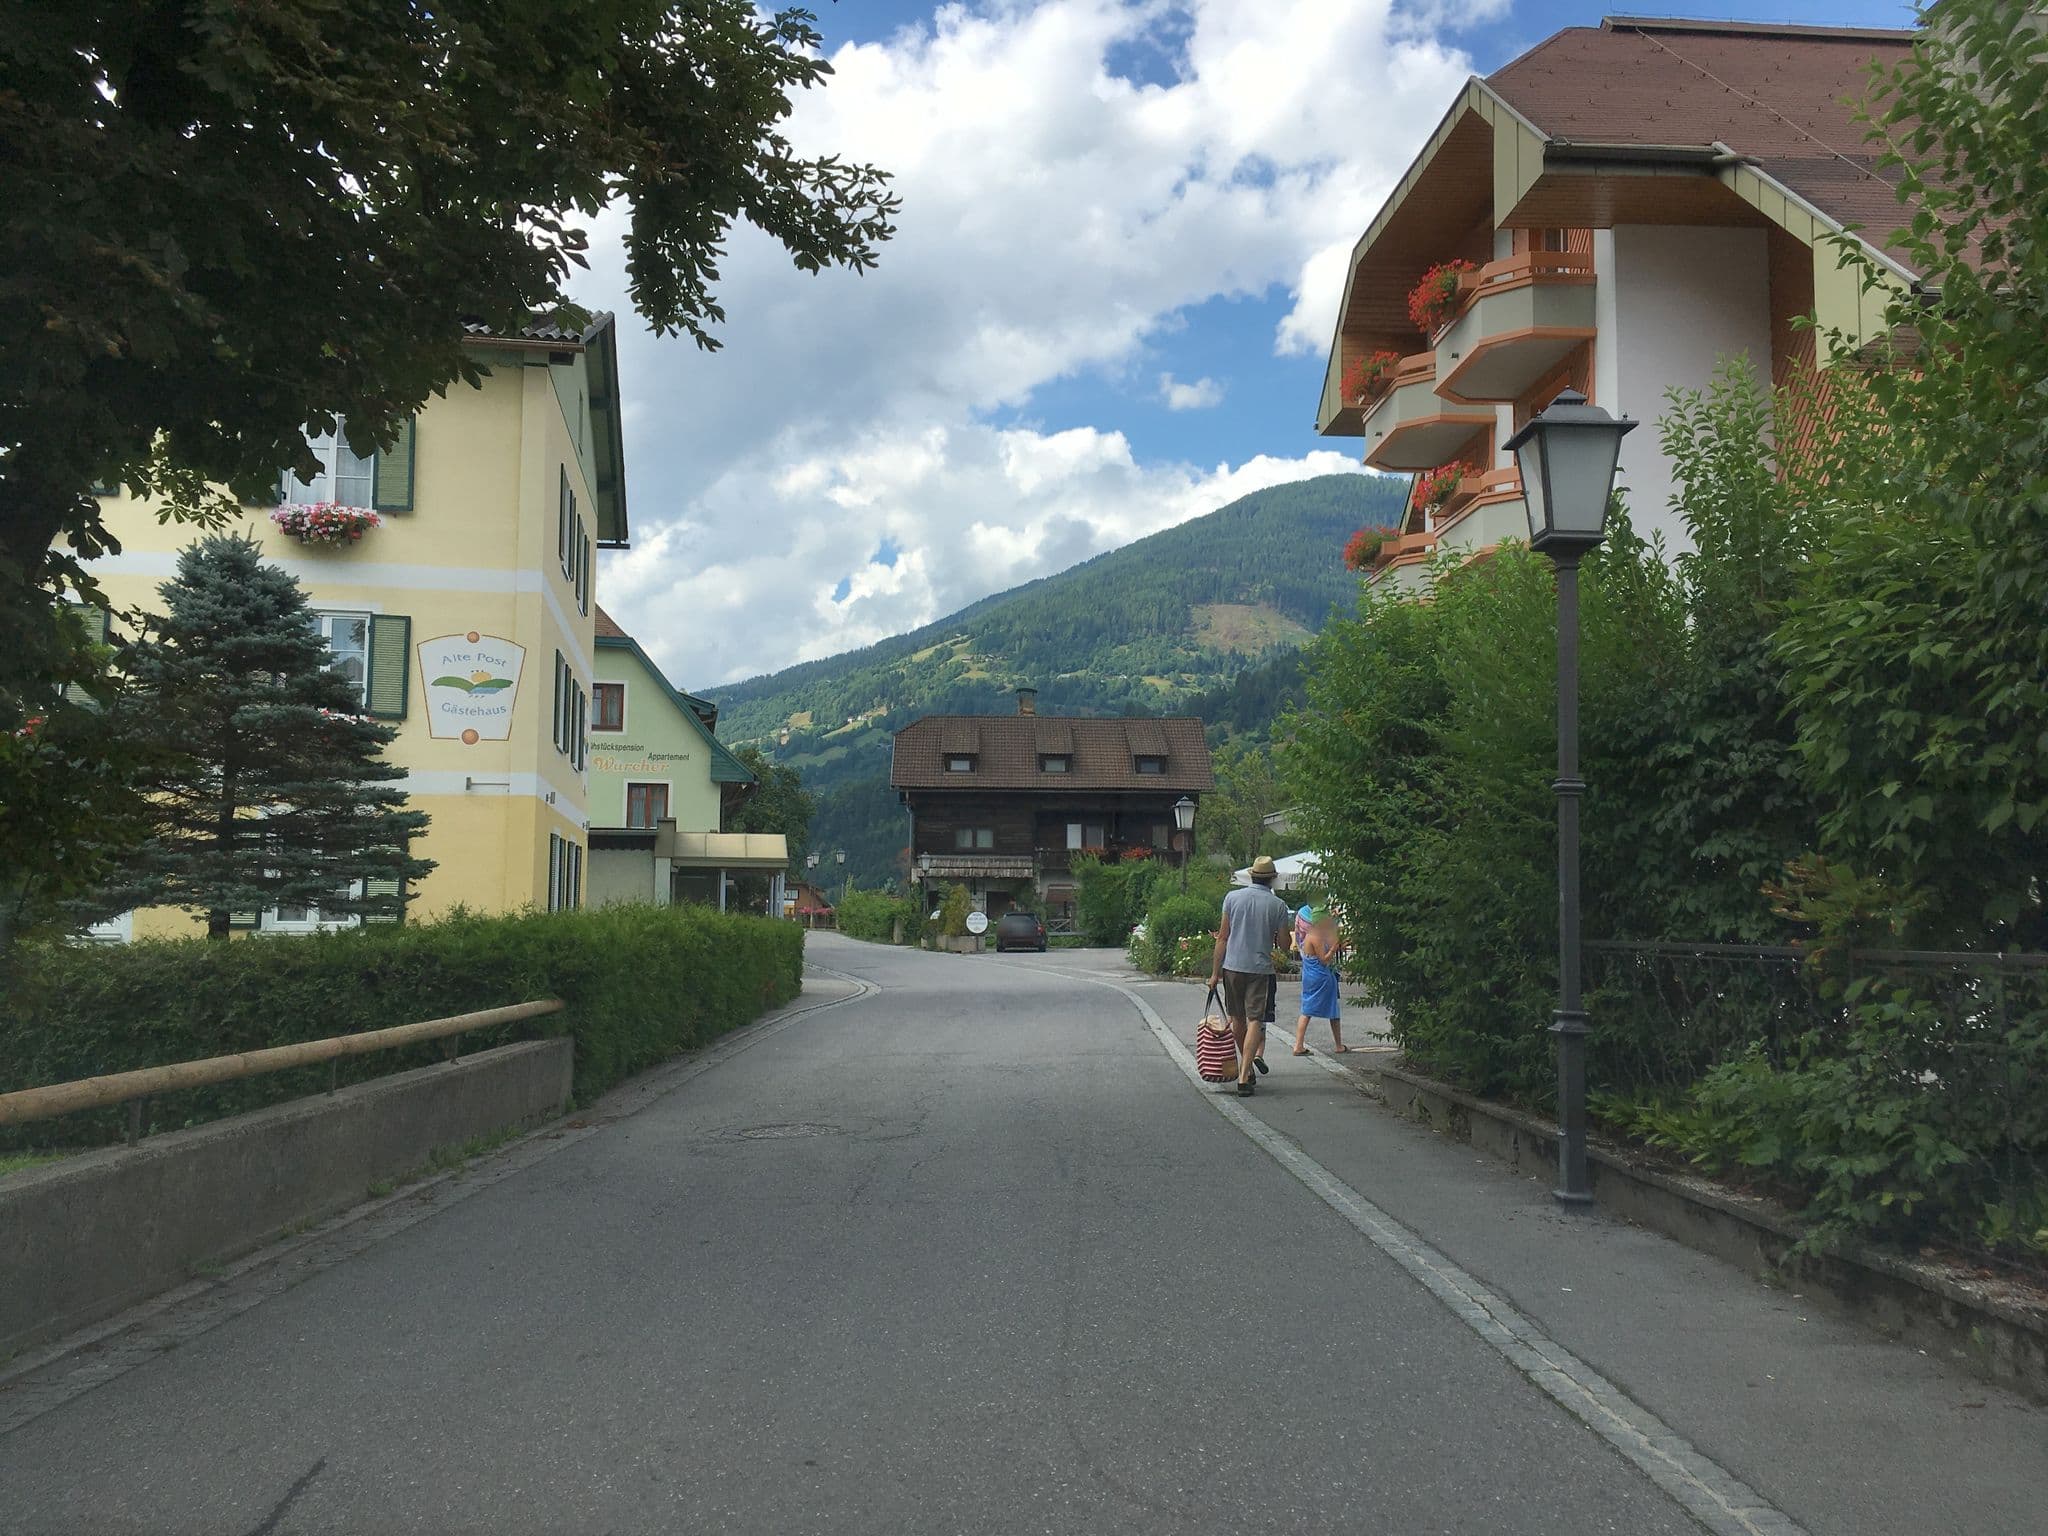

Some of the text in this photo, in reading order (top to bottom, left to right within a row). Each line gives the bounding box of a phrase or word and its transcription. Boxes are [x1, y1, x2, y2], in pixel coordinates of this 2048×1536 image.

[442, 652, 507, 667] Alte Post
[441, 702, 507, 717] Gästehaus
[647, 752, 690, 762] Appartement
